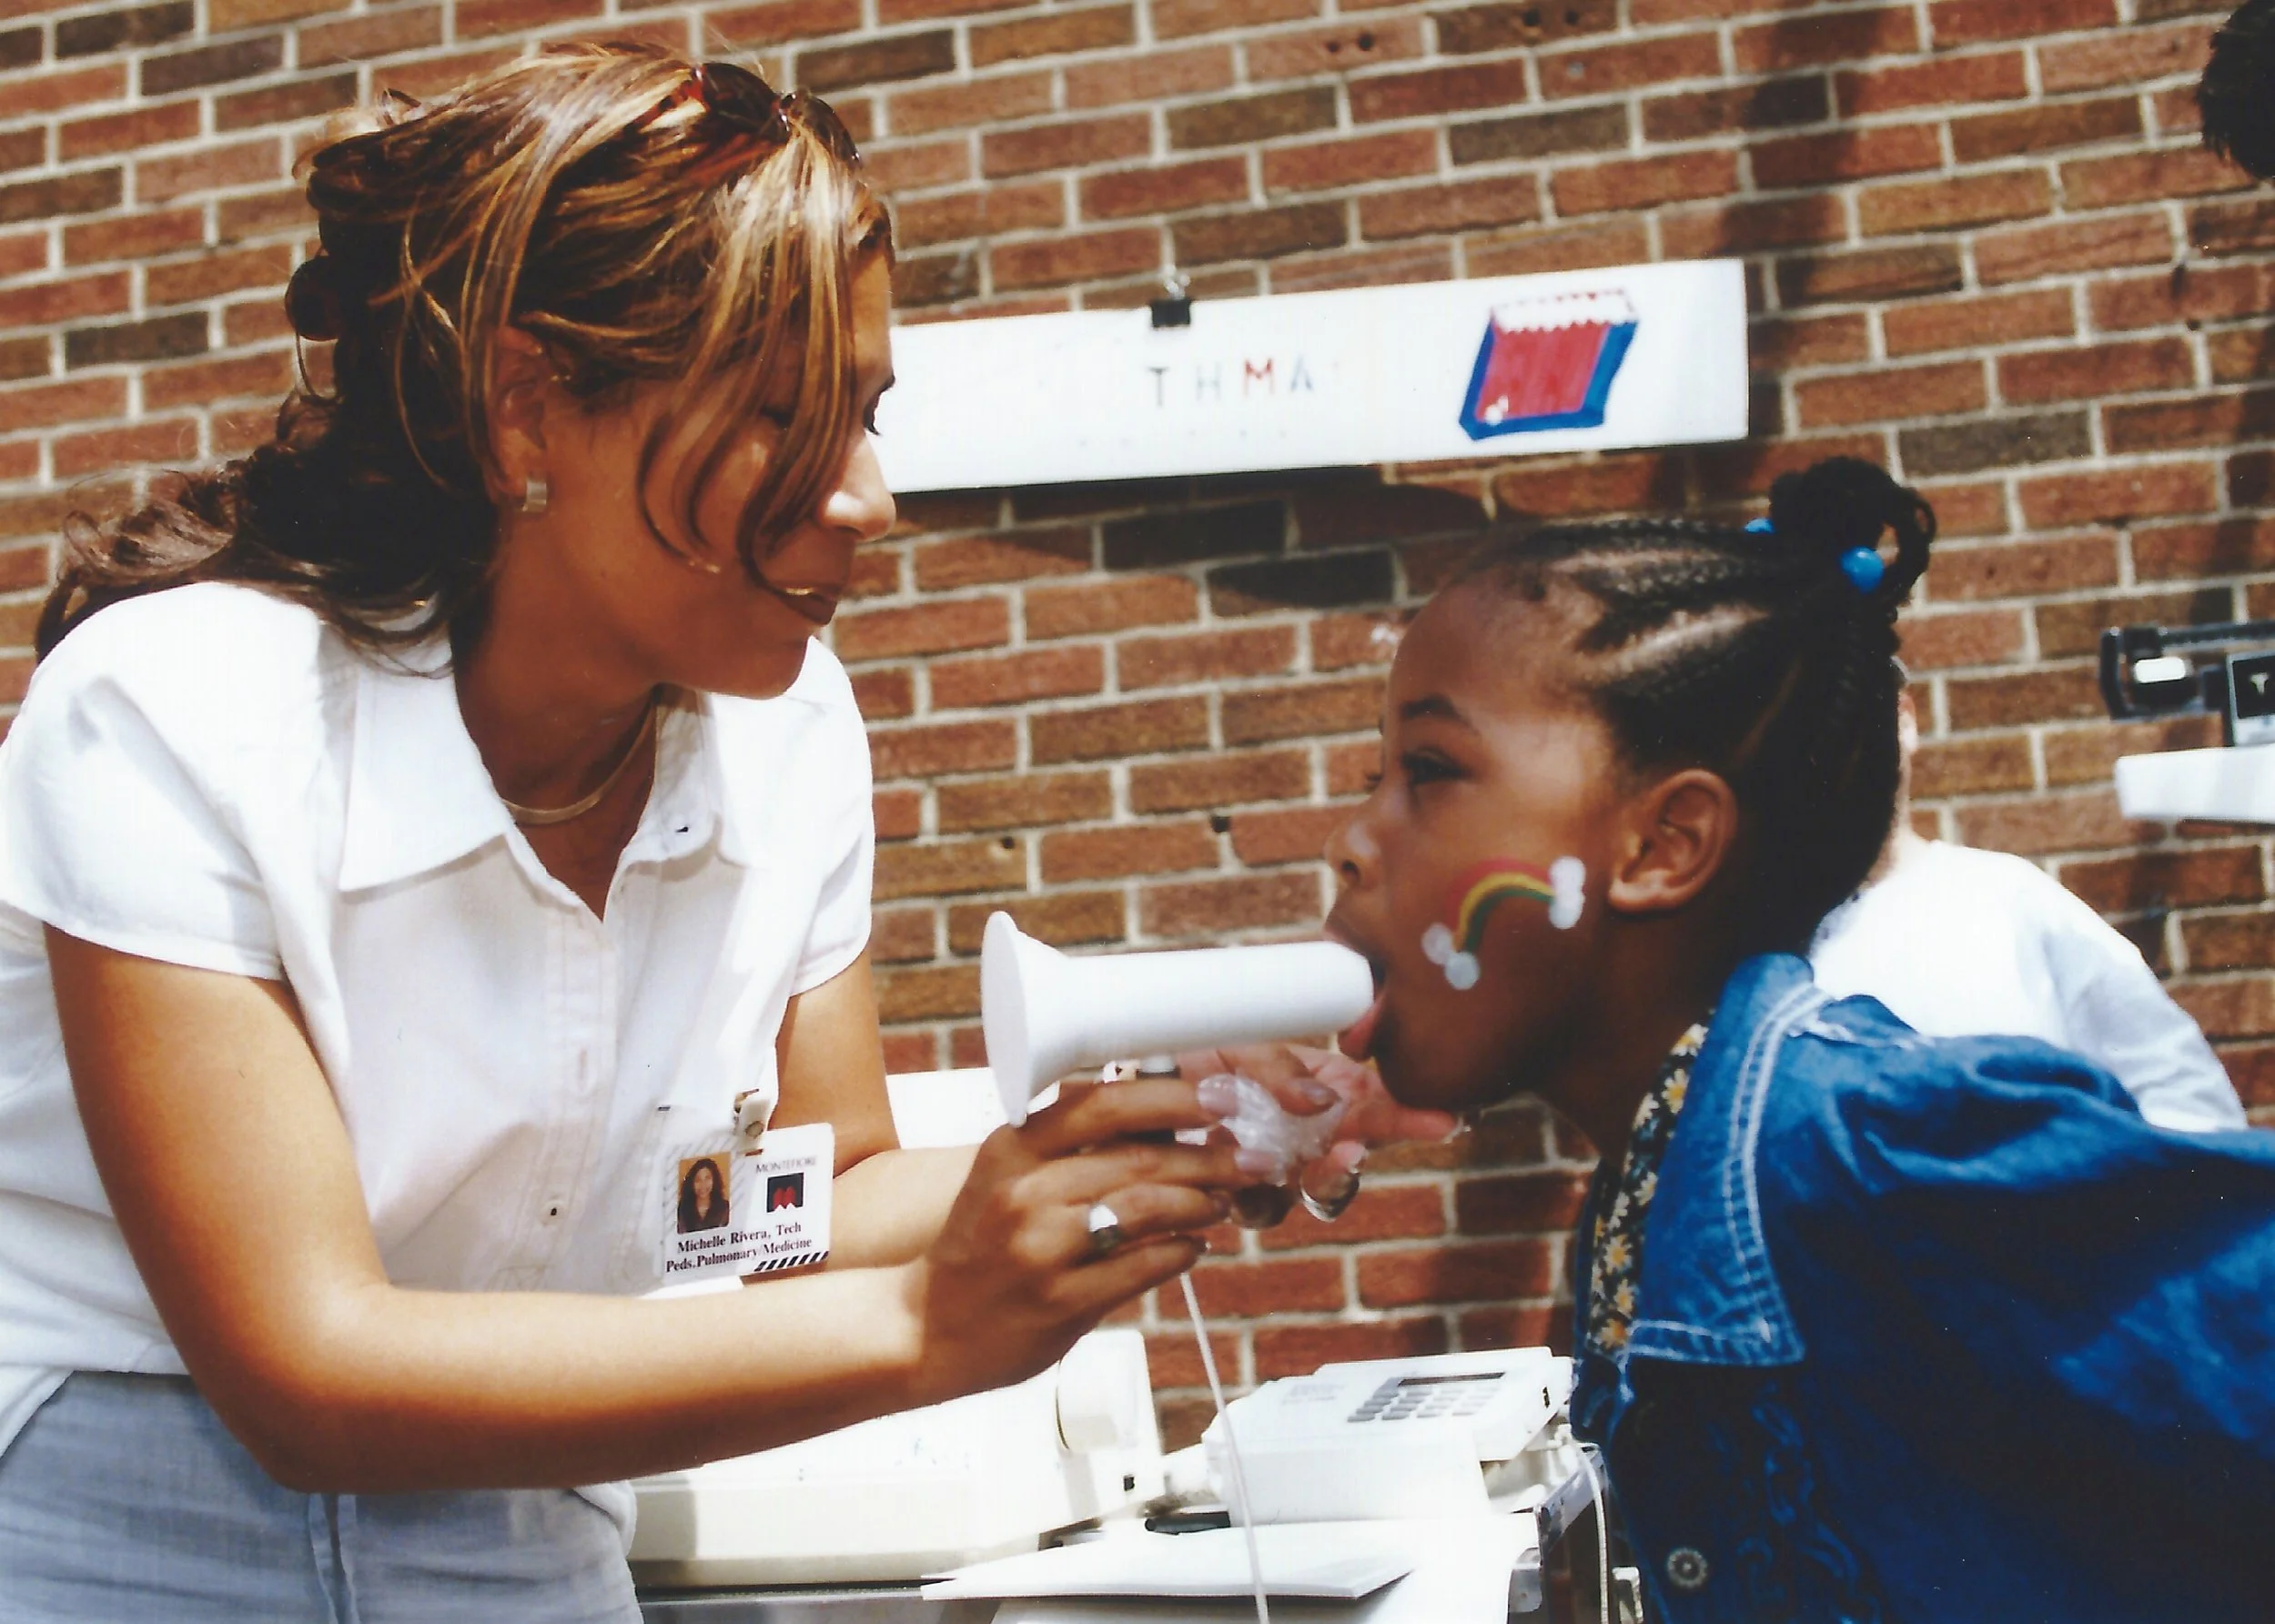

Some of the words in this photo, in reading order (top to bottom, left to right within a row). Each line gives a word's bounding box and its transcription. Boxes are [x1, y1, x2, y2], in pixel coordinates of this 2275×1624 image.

[677, 1235, 726, 1255] Michelle
[730, 1230, 772, 1245] Rivera,
[776, 1222, 802, 1236] Tech
